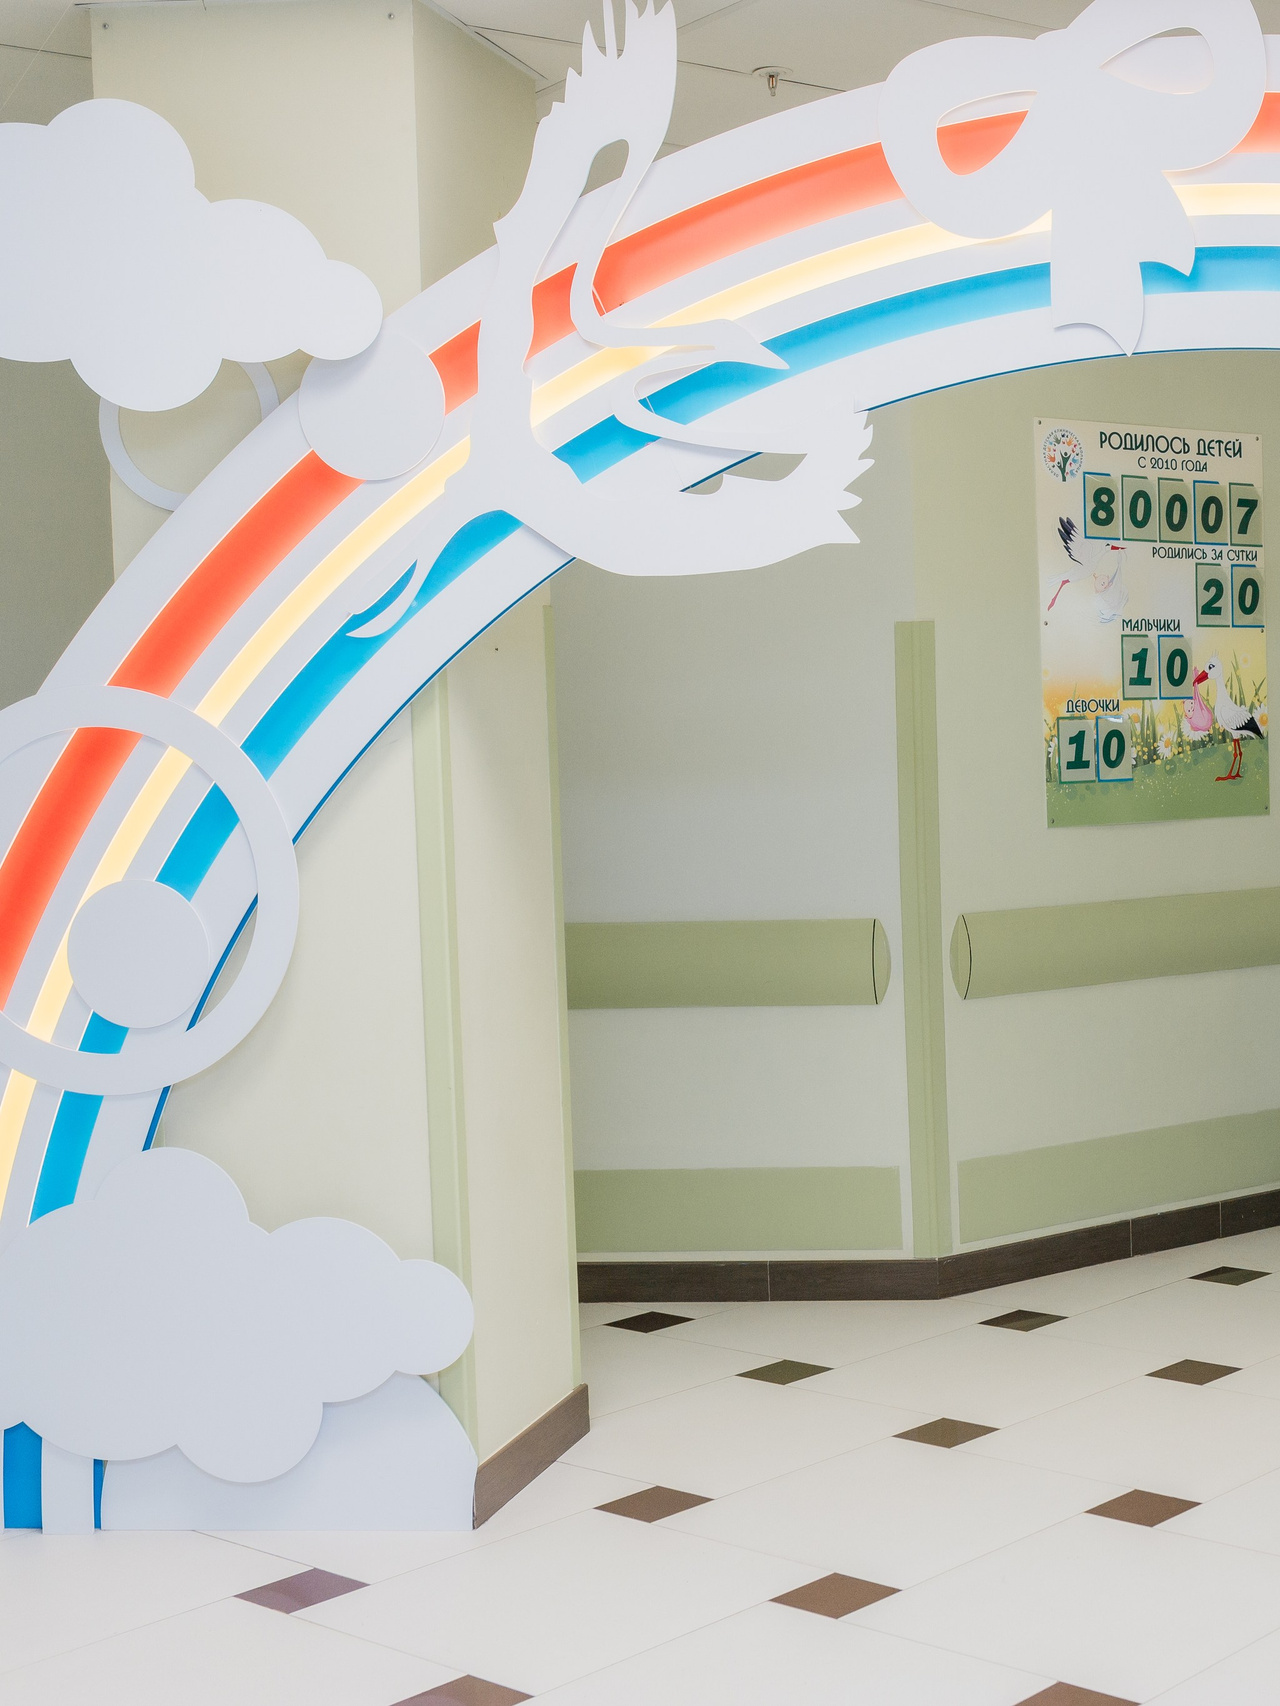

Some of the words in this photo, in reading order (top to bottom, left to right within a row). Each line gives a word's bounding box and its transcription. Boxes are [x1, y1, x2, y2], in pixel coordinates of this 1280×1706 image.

[1099, 431, 1190, 454] РОДИЛОСЬ
[1196, 438, 1242, 458] ДЕТЕЙ
[1137, 456, 1147, 468] С
[1150, 458, 1178, 471] 2010
[1181, 459, 1208, 472] ГОДА
[1152, 546, 1207, 560] РОДИЛИСЬ
[1211, 549, 1223, 561] ЗА
[1227, 549, 1258, 562] СУТКИ
[1122, 618, 1181, 632] МАЛЬЧИКИ
[1066, 698, 1120, 713] ДЕВОЧКИ
